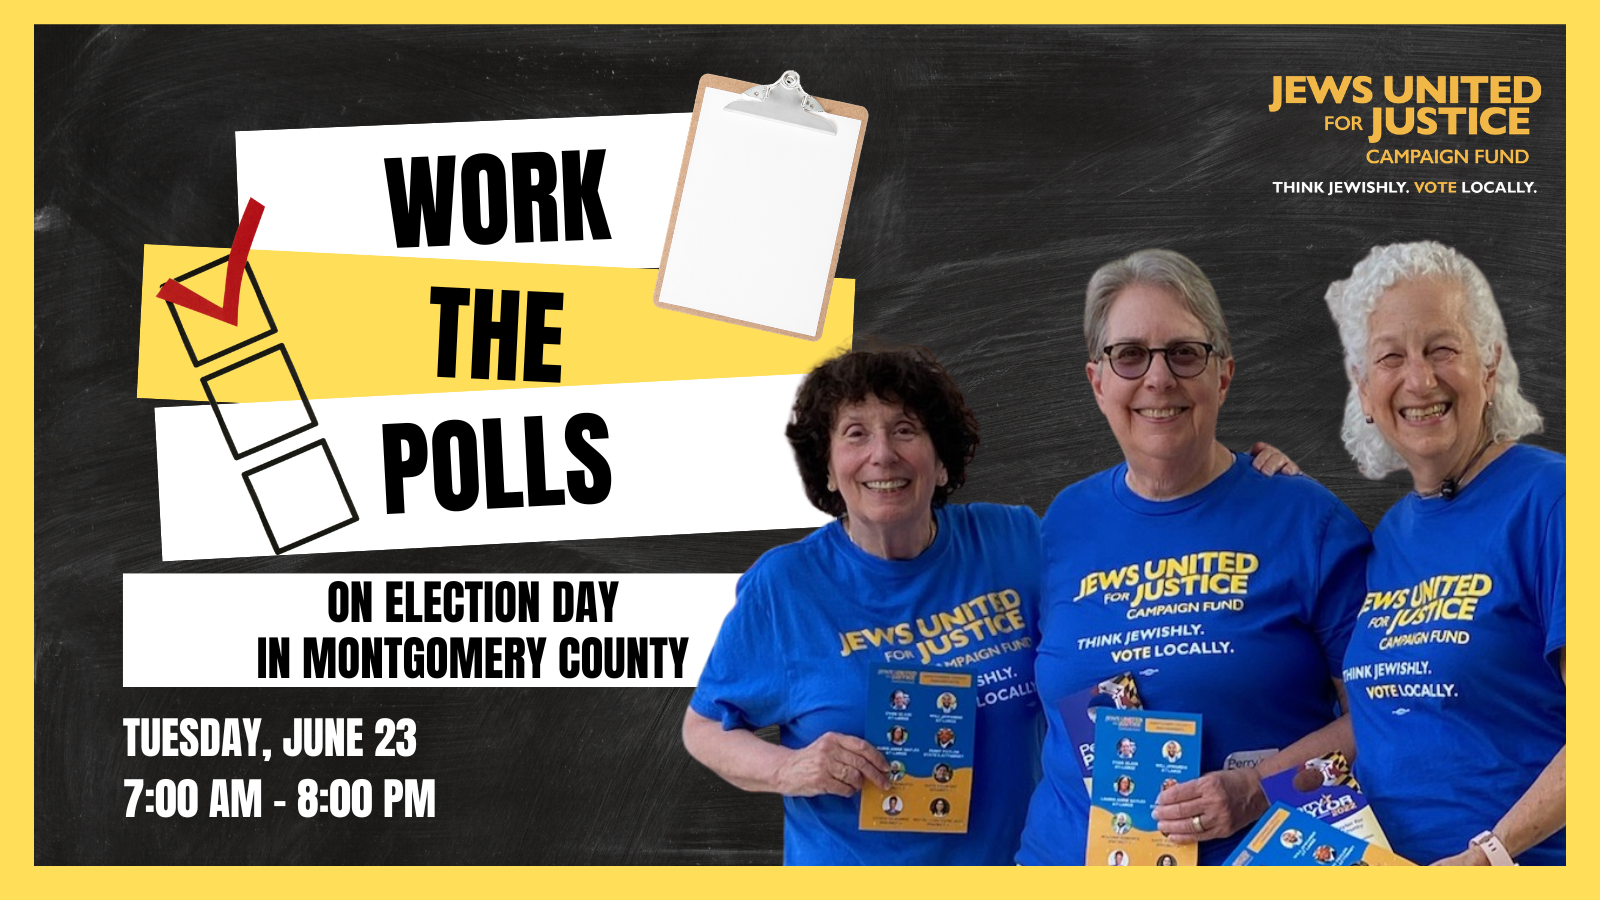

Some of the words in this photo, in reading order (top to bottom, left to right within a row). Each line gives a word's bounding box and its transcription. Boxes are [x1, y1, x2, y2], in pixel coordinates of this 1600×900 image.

[1073, 564, 1140, 602] JEWS
[1144, 551, 1259, 579] UNITED
[1103, 592, 1130, 605] FOR
[1130, 573, 1248, 608] JUSTICE
[1126, 602, 1199, 620] CAMPAIGN
[1203, 598, 1244, 612] FUND
[1357, 588, 1410, 618] EWS
[1410, 573, 1493, 608] UNITED
[840, 623, 914, 657] JEWS
[916, 589, 1021, 638] UNITED
[1367, 616, 1390, 629] FOR
[1386, 596, 1479, 635] JUSTICE
[884, 650, 915, 662] FOR
[916, 609, 1026, 664] JUSTICE
[1077, 633, 1122, 650] THINK
[1124, 624, 1205, 646] JEWISHLY.
[1379, 631, 1429, 650] CAMPAIGN
[1430, 630, 1470, 645] FUND
[936, 645, 1001, 668] MPAIGN
[1001, 637, 1033, 655] FUND
[1111, 646, 1151, 663] VOTE
[1154, 641, 1235, 658] LOCALLY.
[977, 666, 1018, 687] SHLY.
[1342, 664, 1373, 683] THINK
[1374, 661, 1432, 681] JEWISHLY.
[1366, 684, 1399, 699] VOTE
[1398, 684, 1459, 698] LOCALLY.
